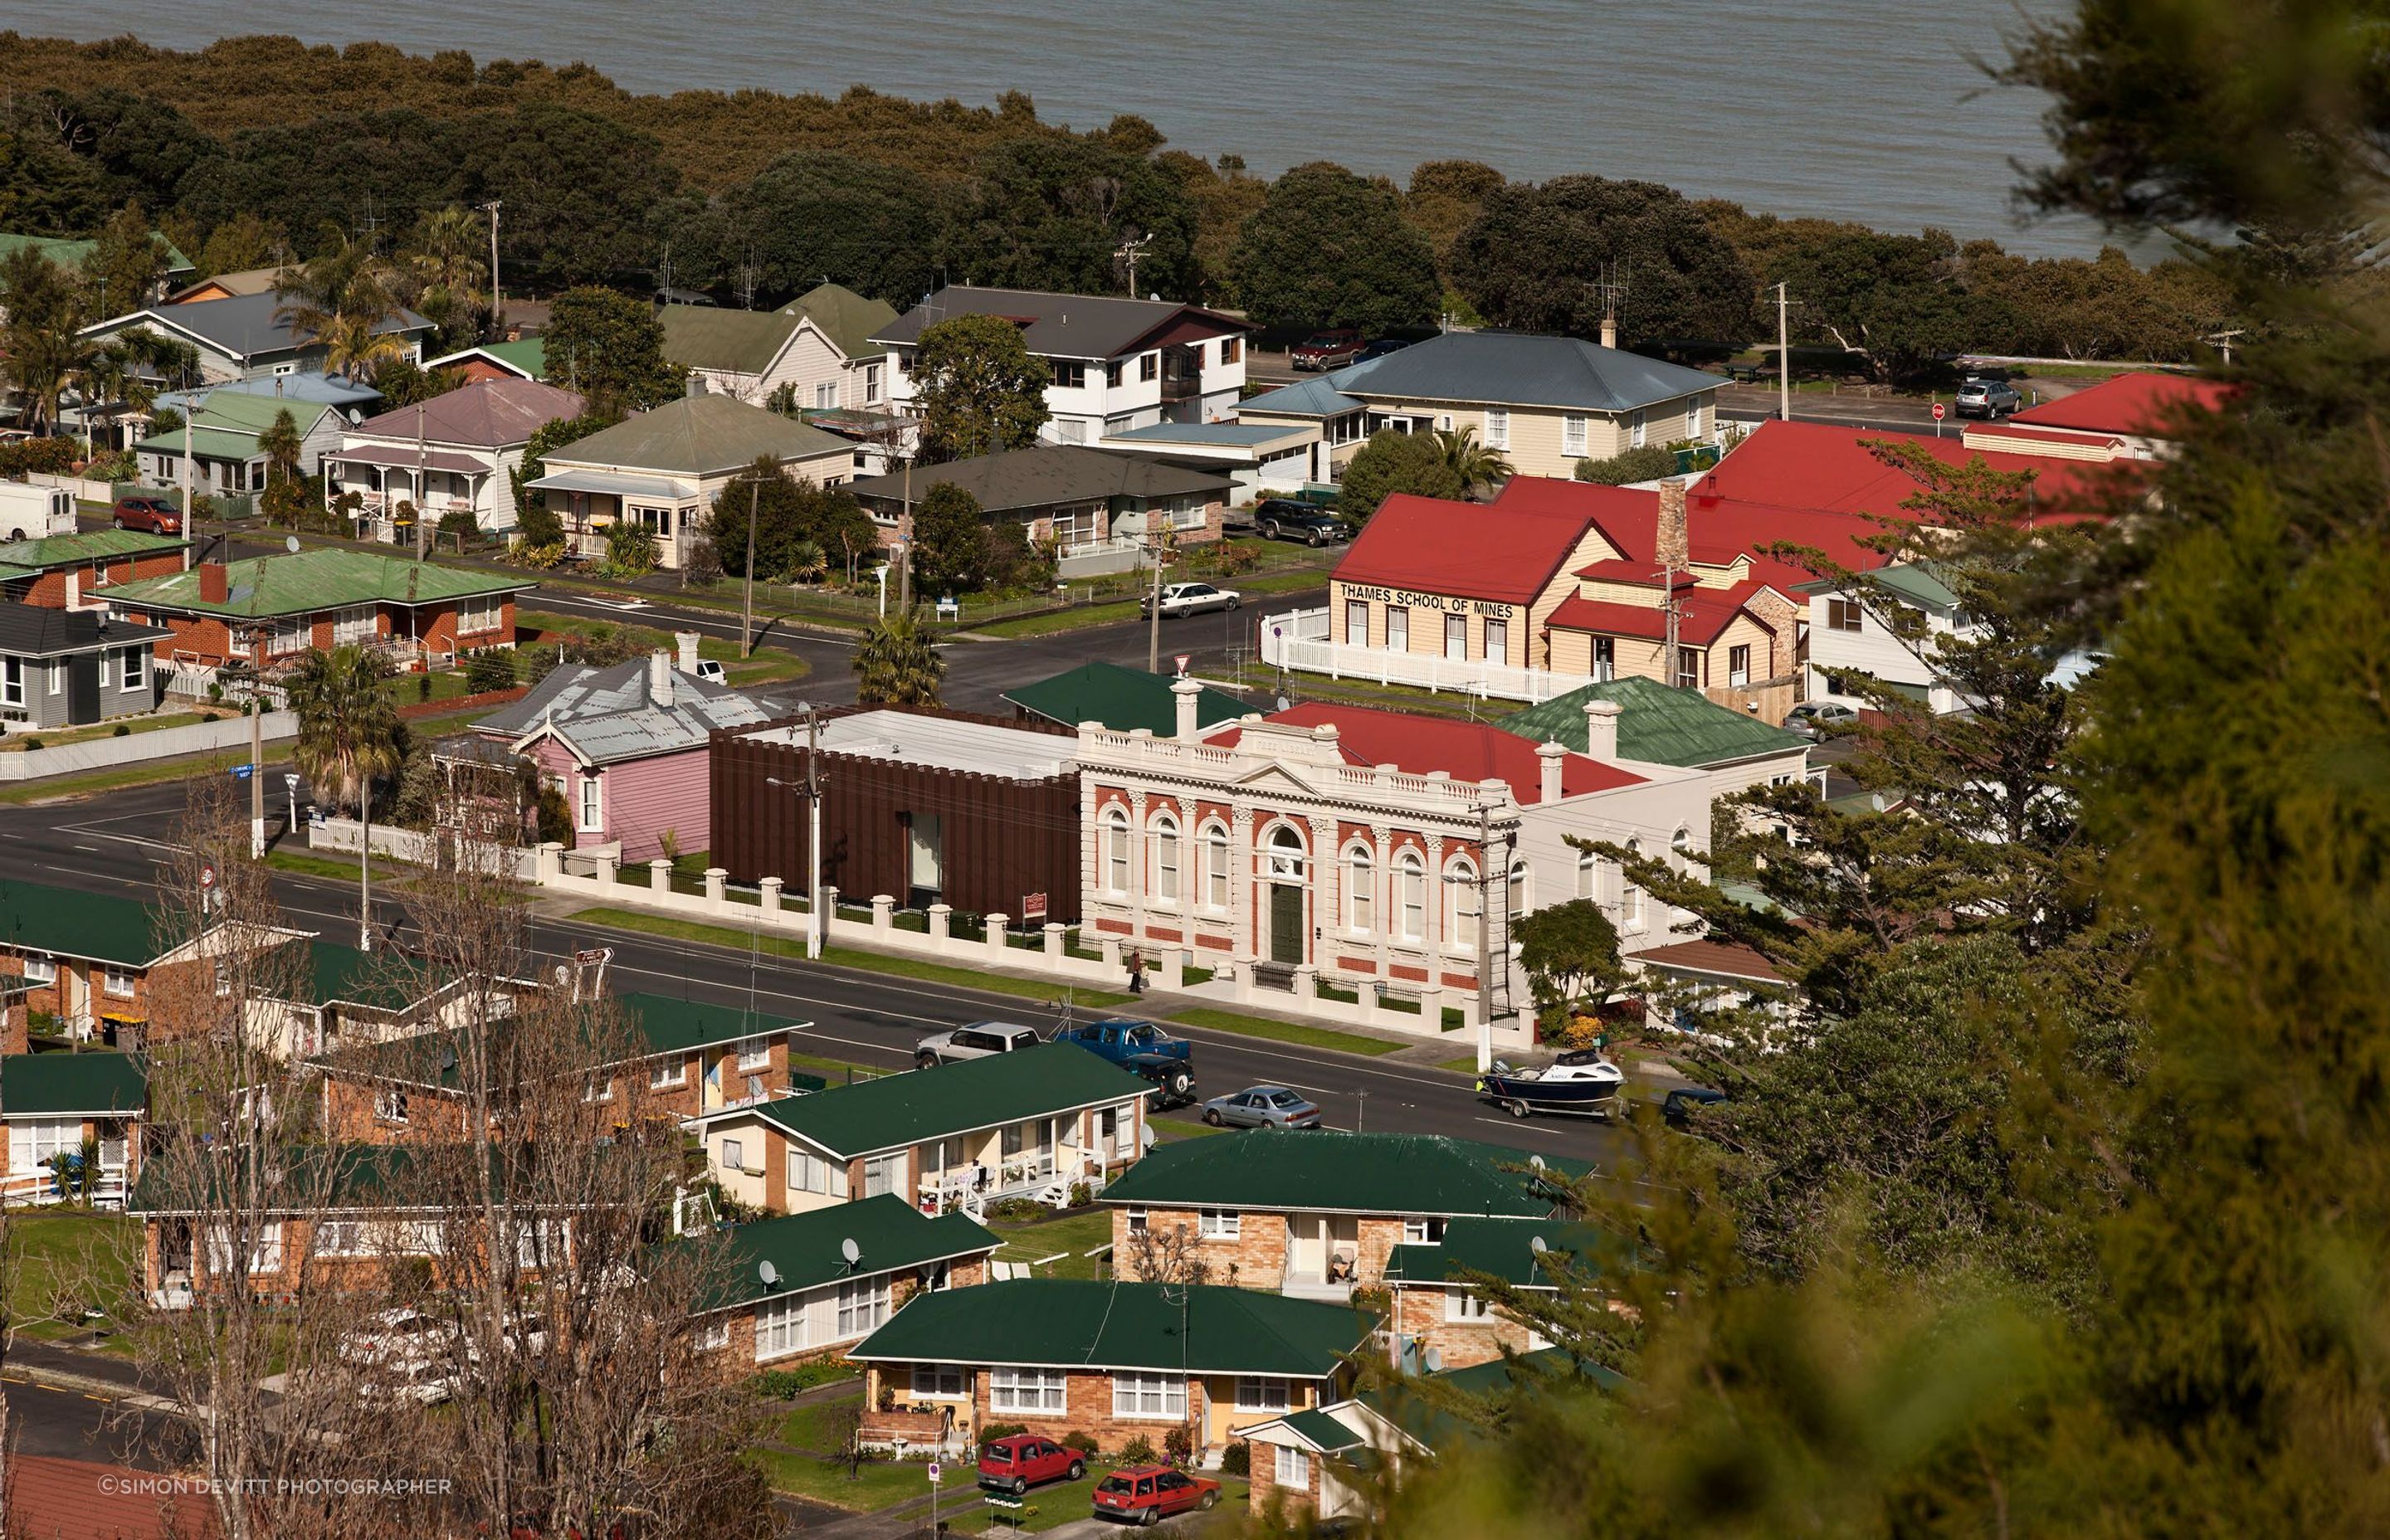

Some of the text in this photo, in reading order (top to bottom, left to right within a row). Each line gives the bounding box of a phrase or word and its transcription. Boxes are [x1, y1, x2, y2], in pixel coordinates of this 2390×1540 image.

[1341, 584, 1513, 618] THAMES SCHOOL OF MINES
